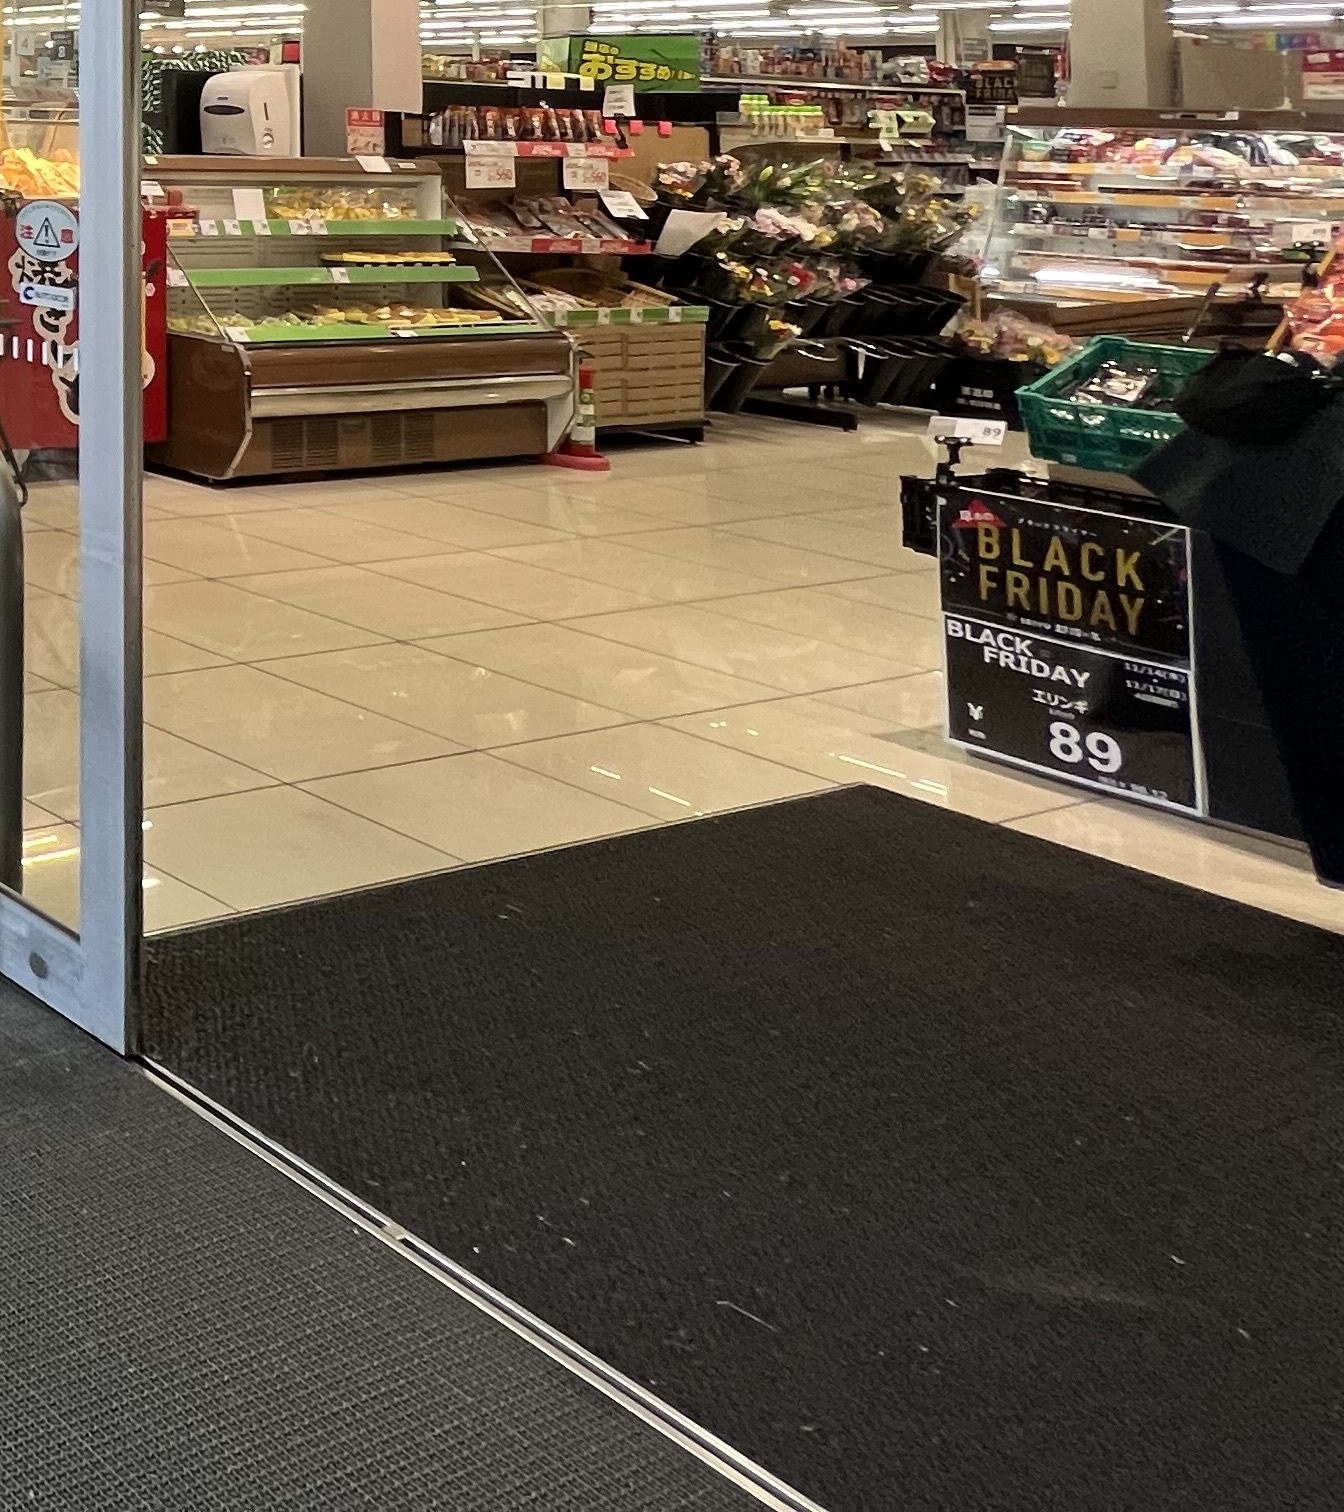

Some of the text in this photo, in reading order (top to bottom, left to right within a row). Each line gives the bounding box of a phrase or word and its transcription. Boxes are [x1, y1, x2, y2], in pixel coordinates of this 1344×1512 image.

[982, 426, 1002, 437] 89
[976, 521, 1146, 592] BLACK
[979, 562, 1146, 636] FRIDAY
[945, 618, 1035, 658] BLACK
[982, 644, 1091, 689] FRIDAY
[967, 702, 984, 721] ¥
[1031, 688, 1089, 715] エリンギ
[1049, 721, 1122, 774] 89
